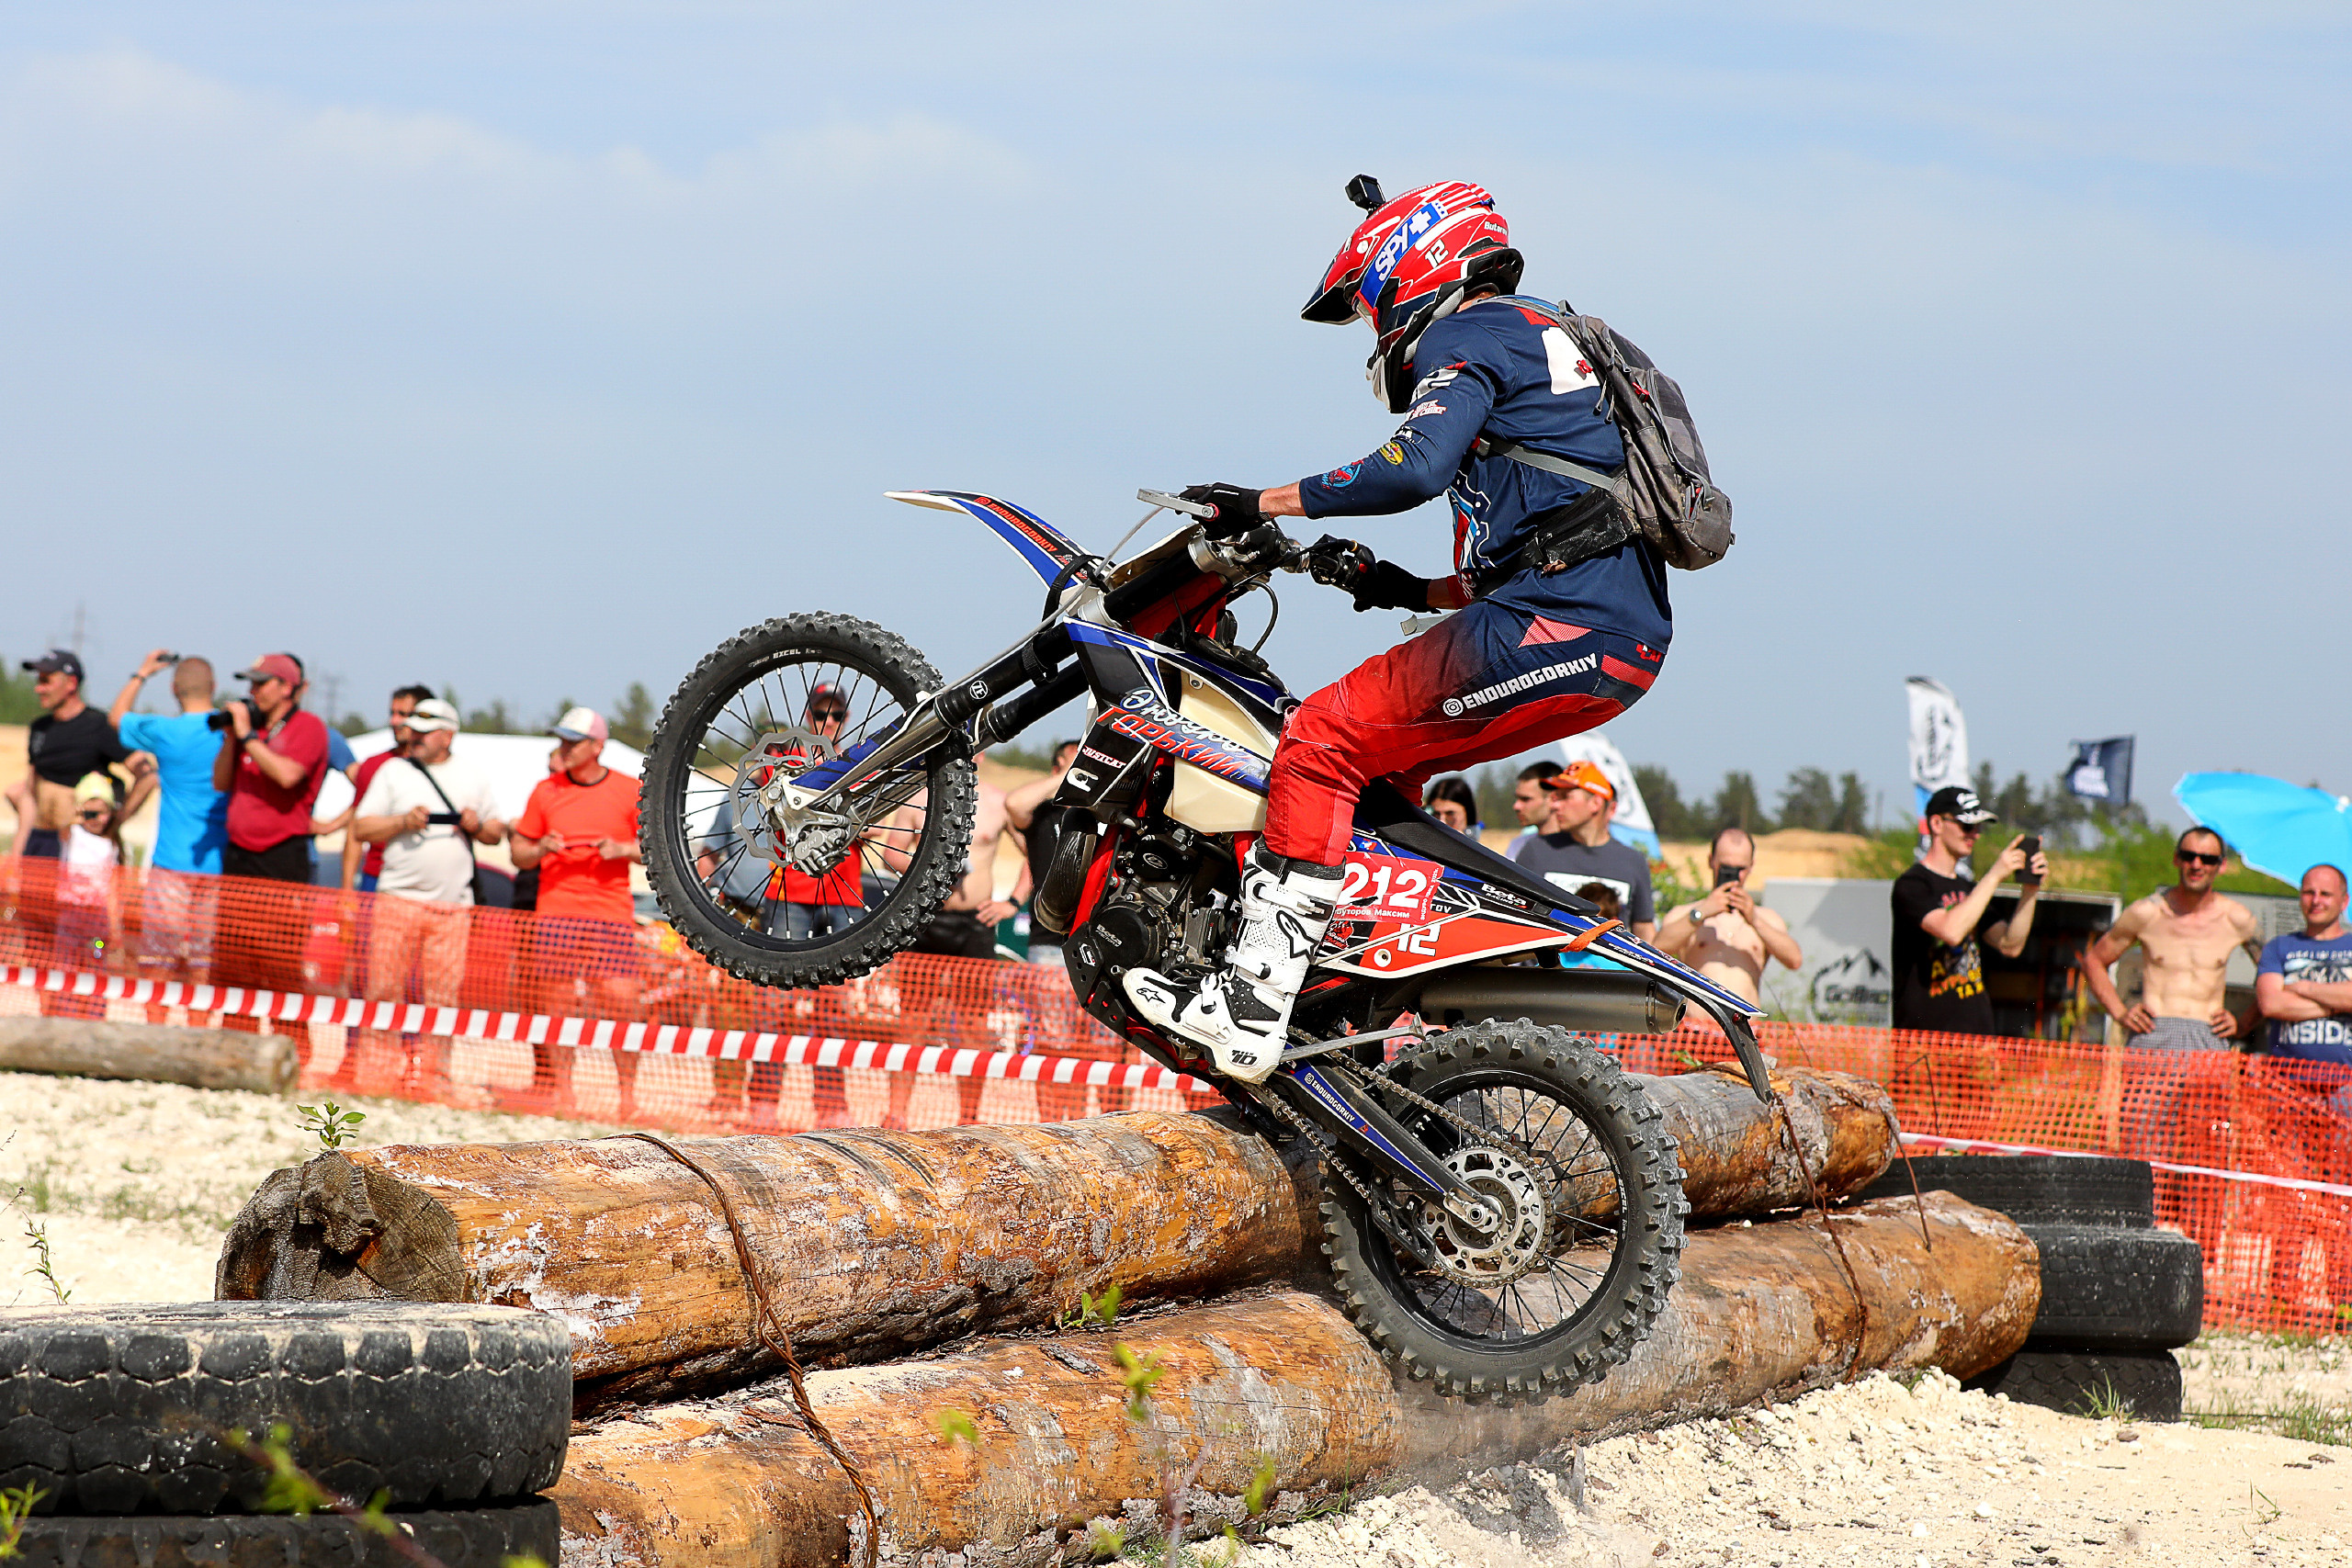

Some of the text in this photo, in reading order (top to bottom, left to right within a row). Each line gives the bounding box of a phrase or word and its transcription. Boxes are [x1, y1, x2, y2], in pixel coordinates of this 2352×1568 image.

[1425, 238, 1450, 269] 12
[773, 649, 801, 659] EXCEL
[1463, 652, 1598, 709] ENDUROGORKIY
[1337, 862, 1428, 909] 212
[1481, 883, 1527, 906] Beta
[1374, 908, 1410, 919] Максим
[1396, 922, 1442, 957] 12
[1311, 1079, 1356, 1122] ENDUROGORKIY
